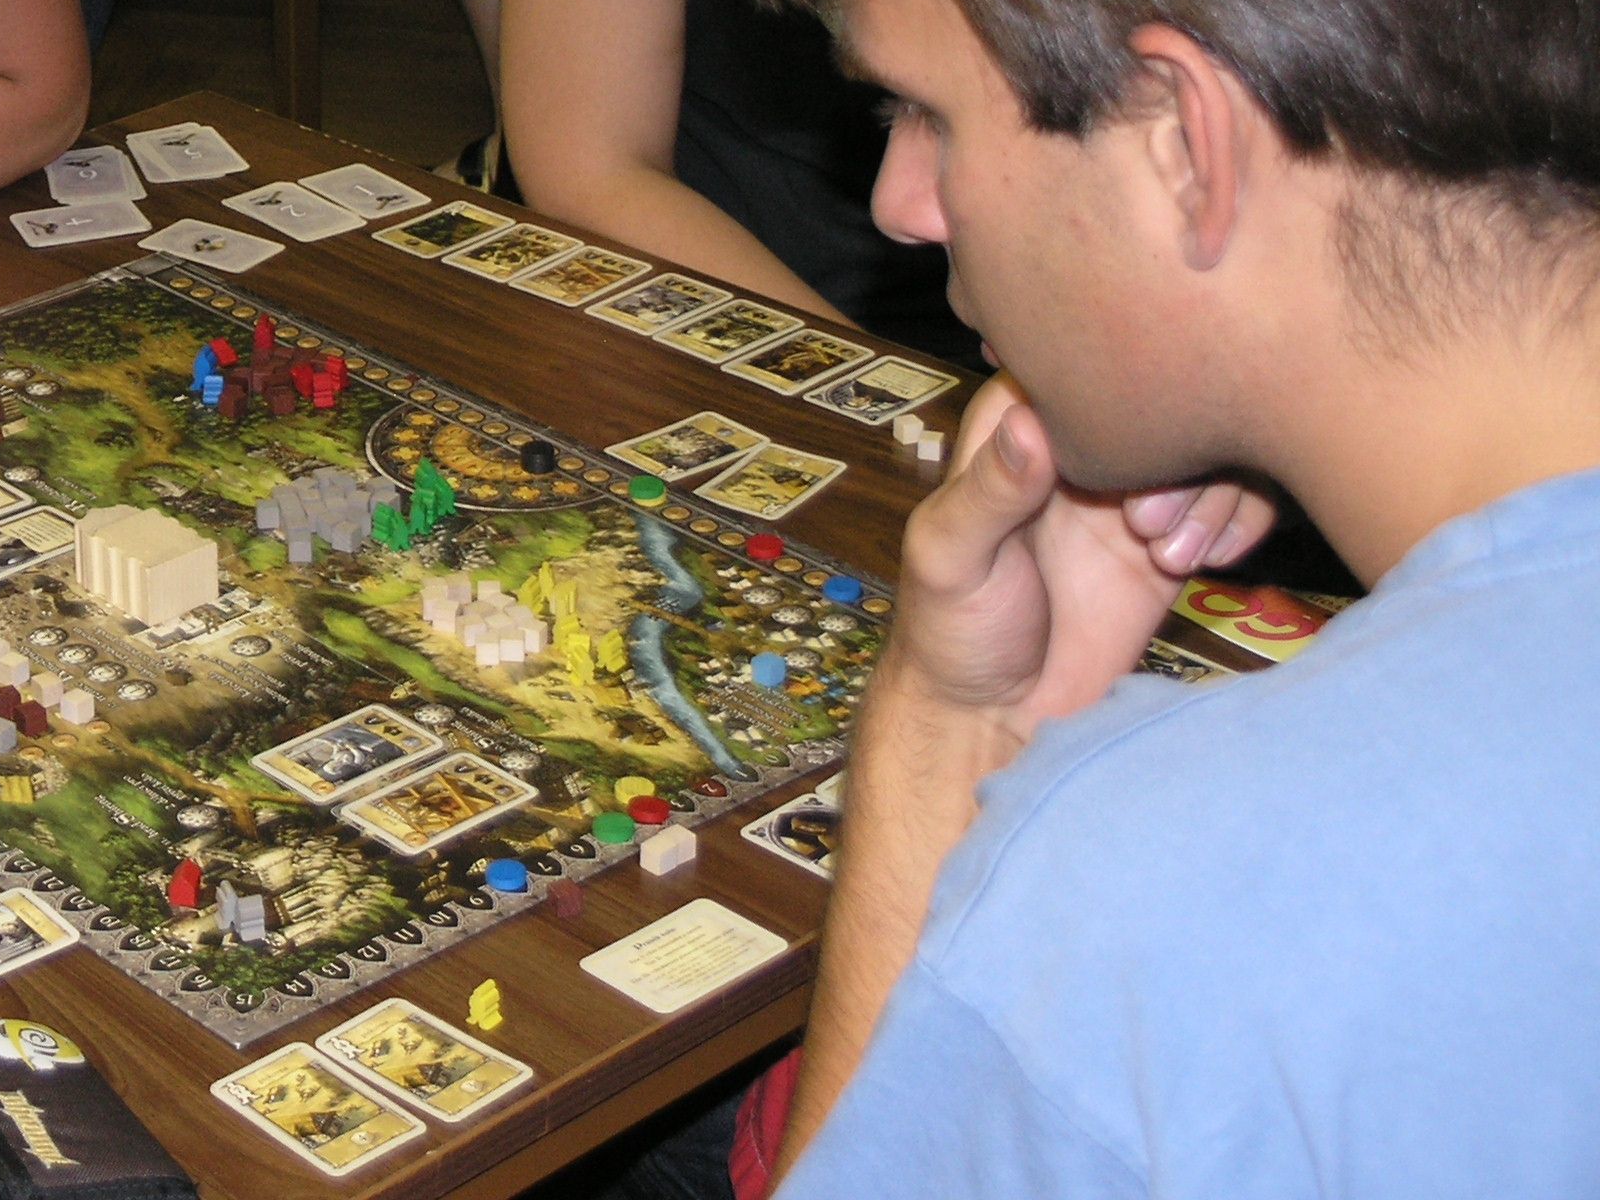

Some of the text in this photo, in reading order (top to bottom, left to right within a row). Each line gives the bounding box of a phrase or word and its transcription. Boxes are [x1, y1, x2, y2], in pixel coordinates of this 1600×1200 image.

[279, 201, 306, 218] 2
[735, 769, 748, 778] 1
[702, 782, 719, 793] 2
[13, 856, 37, 871] 22
[538, 860, 552, 872] 7
[42, 875, 65, 889] 21
[69, 895, 94, 910] 20
[99, 915, 122, 928] 19
[428, 910, 451, 924] 10
[129, 934, 151, 949] 18
[395, 928, 415, 942] 11
[357, 944, 381, 959] 12
[158, 954, 181, 969] 17
[321, 962, 343, 976] 13
[192, 973, 213, 989] 16
[285, 978, 308, 994] 14
[235, 993, 253, 1006] 15
